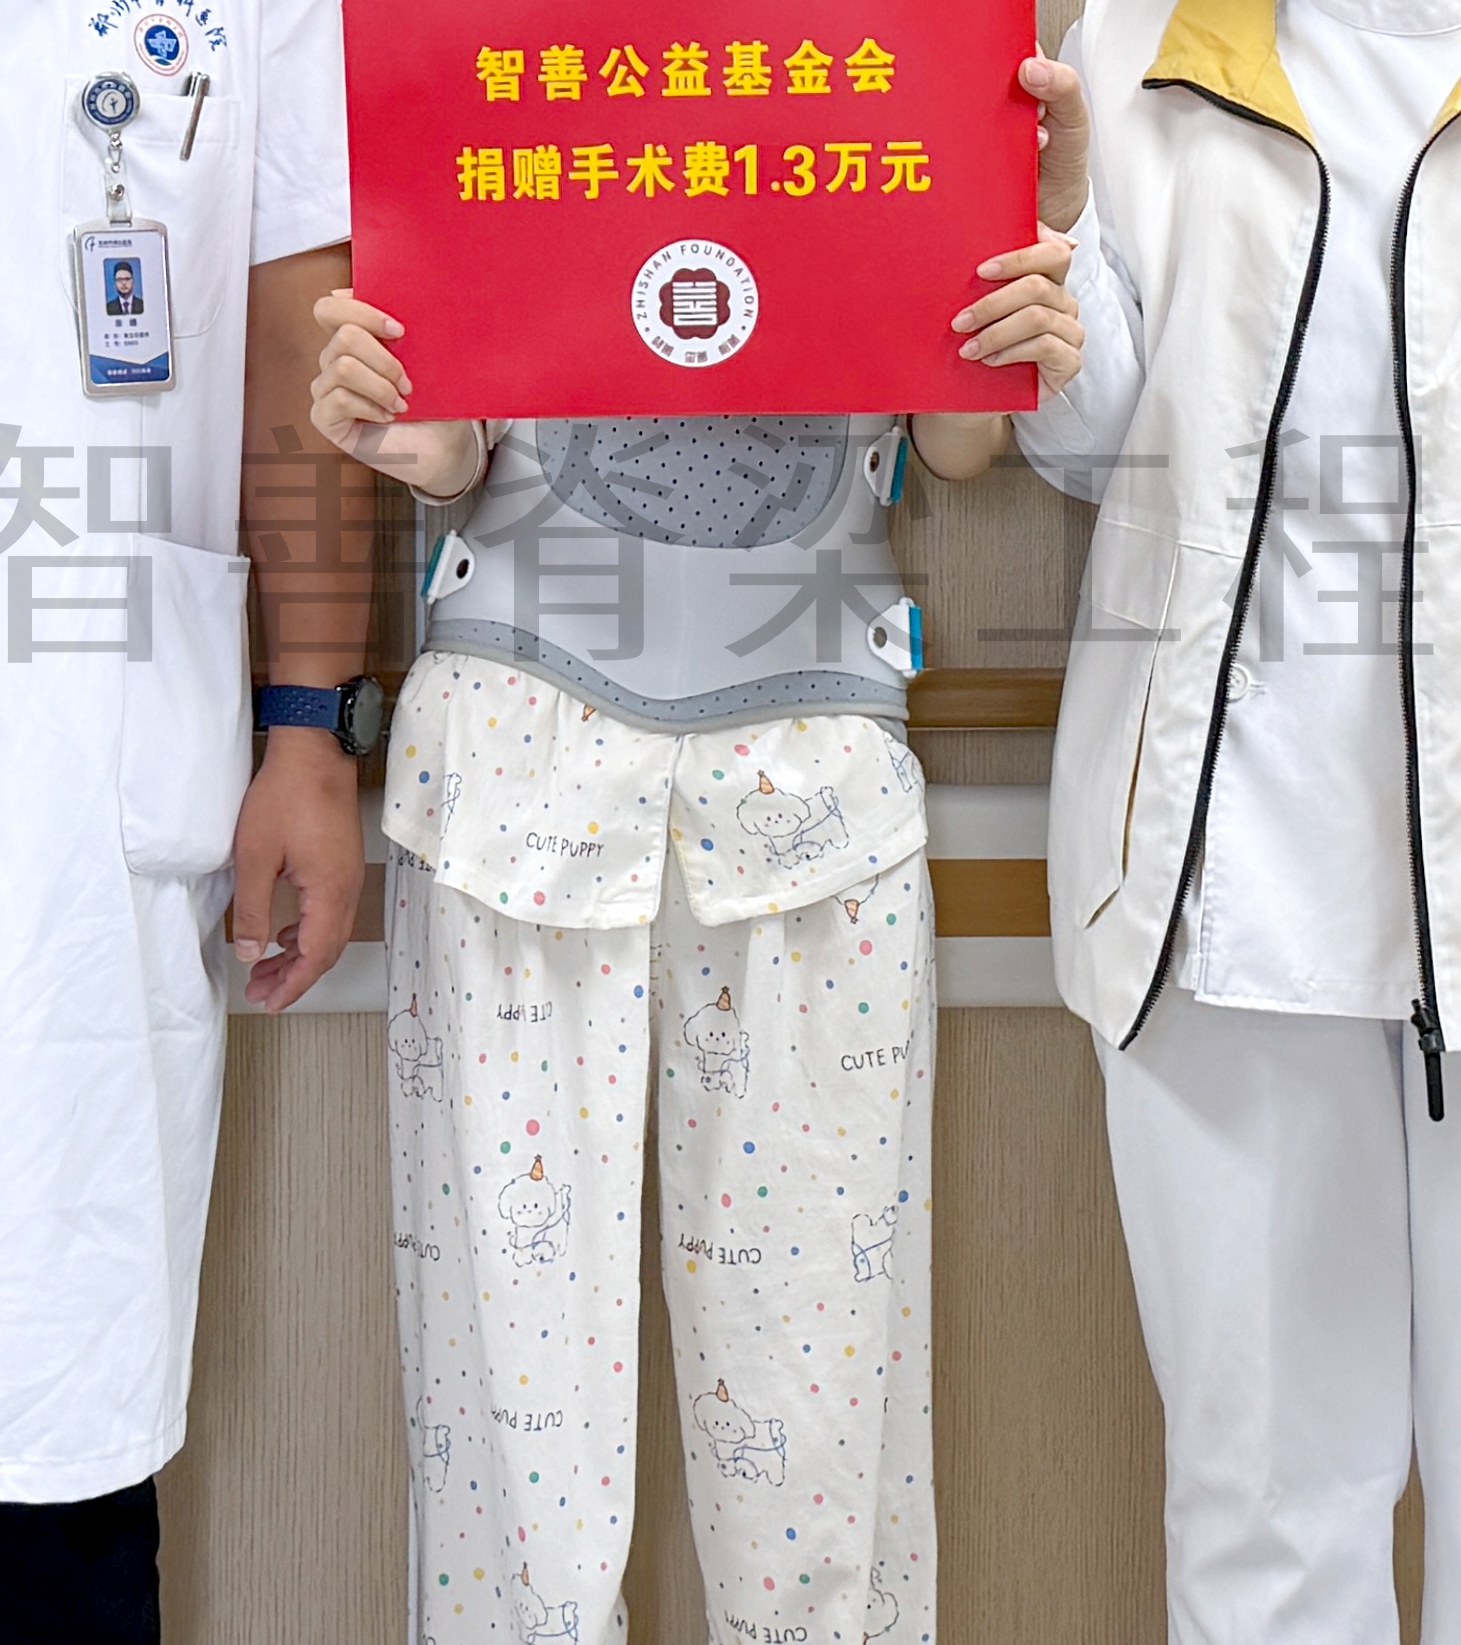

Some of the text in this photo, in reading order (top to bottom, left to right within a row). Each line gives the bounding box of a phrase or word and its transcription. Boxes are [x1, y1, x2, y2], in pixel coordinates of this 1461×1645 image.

[475, 37, 897, 103] 智善公益基金会
[456, 140, 932, 202] 捐赠手术费1.3万元
[635, 243, 755, 321] ZHISHAN FOUNDATION
[526, 831, 605, 858] CUTE PUPPY
[841, 1048, 886, 1071] CUTE
[678, 1233, 762, 1265] CUTE PUPPY
[523, 1409, 564, 1432] CUTE
[762, 1627, 808, 1645] CUTE
